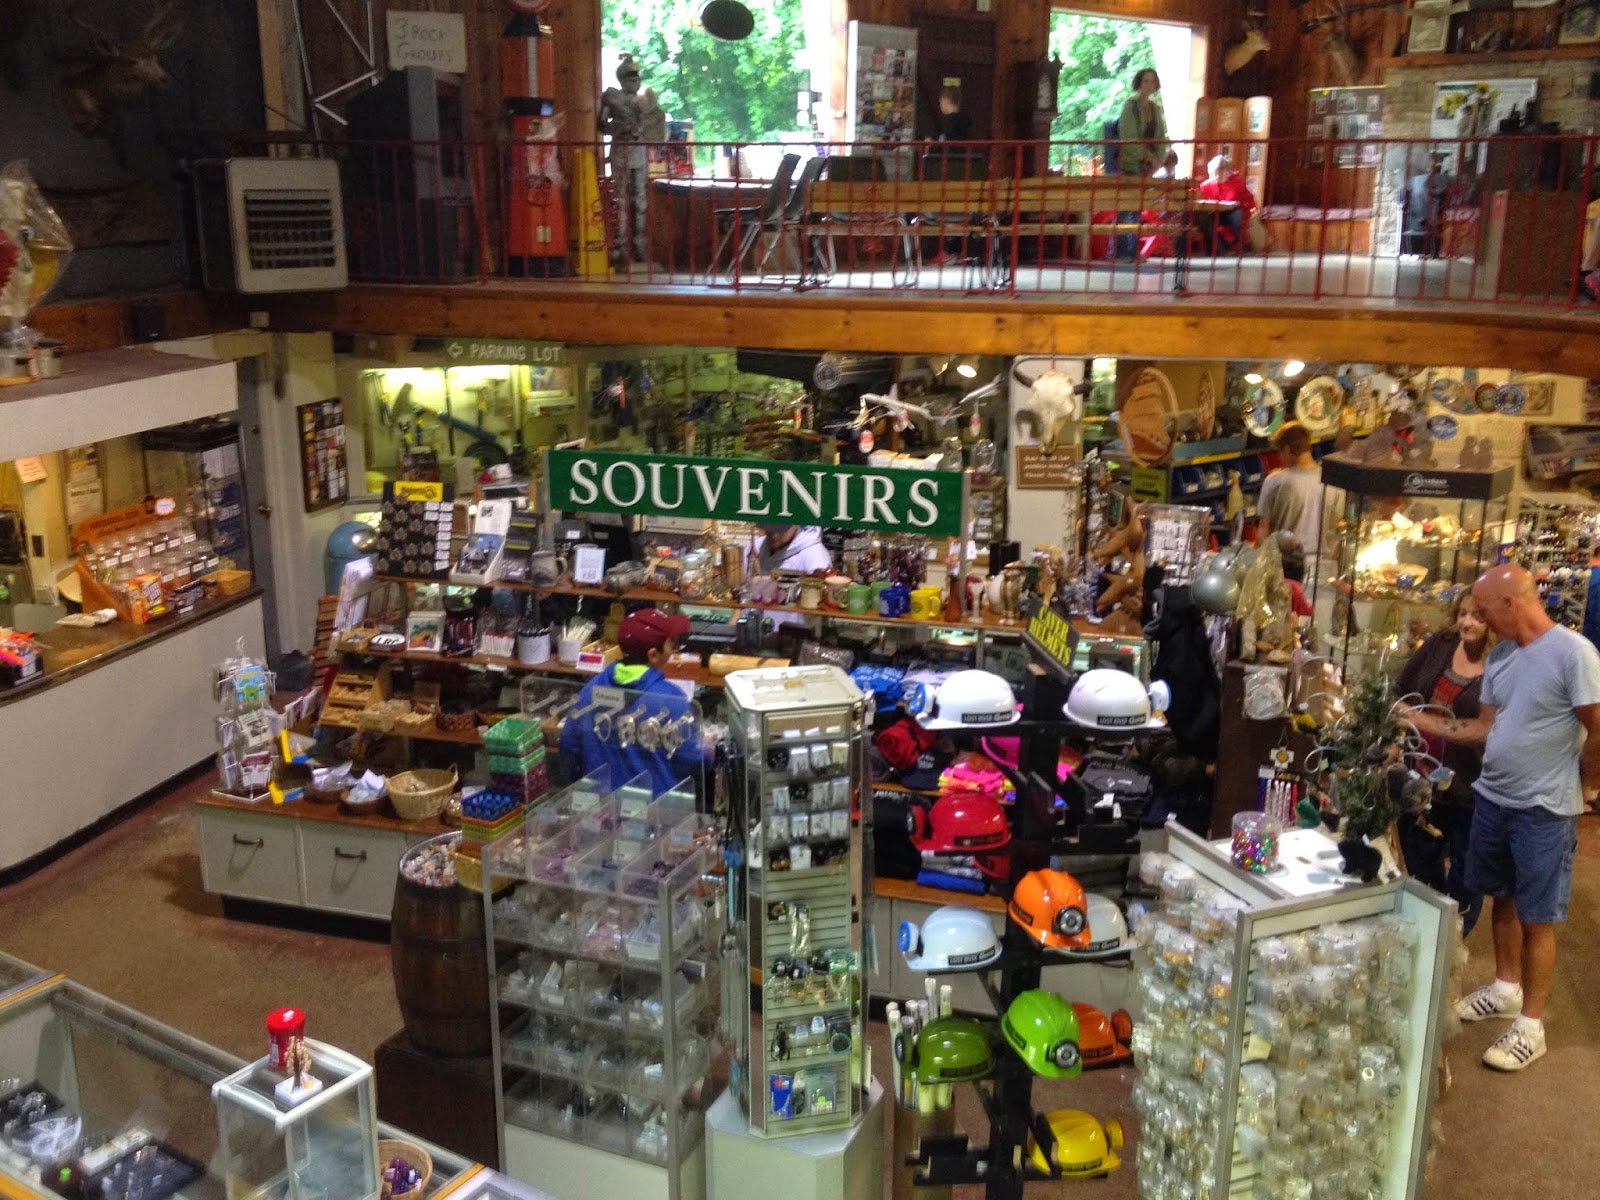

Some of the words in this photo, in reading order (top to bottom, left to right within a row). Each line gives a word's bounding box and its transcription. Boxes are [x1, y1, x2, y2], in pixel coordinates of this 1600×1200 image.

[469, 343, 526, 361] PARKING
[532, 346, 561, 362] LOT
[569, 458, 940, 527] SOUVENIRS
[1038, 604, 1069, 643] CAVER
[1028, 615, 1072, 667] HELMETS
[963, 714, 978, 723] LOST
[1099, 716, 1112, 725] LOST
